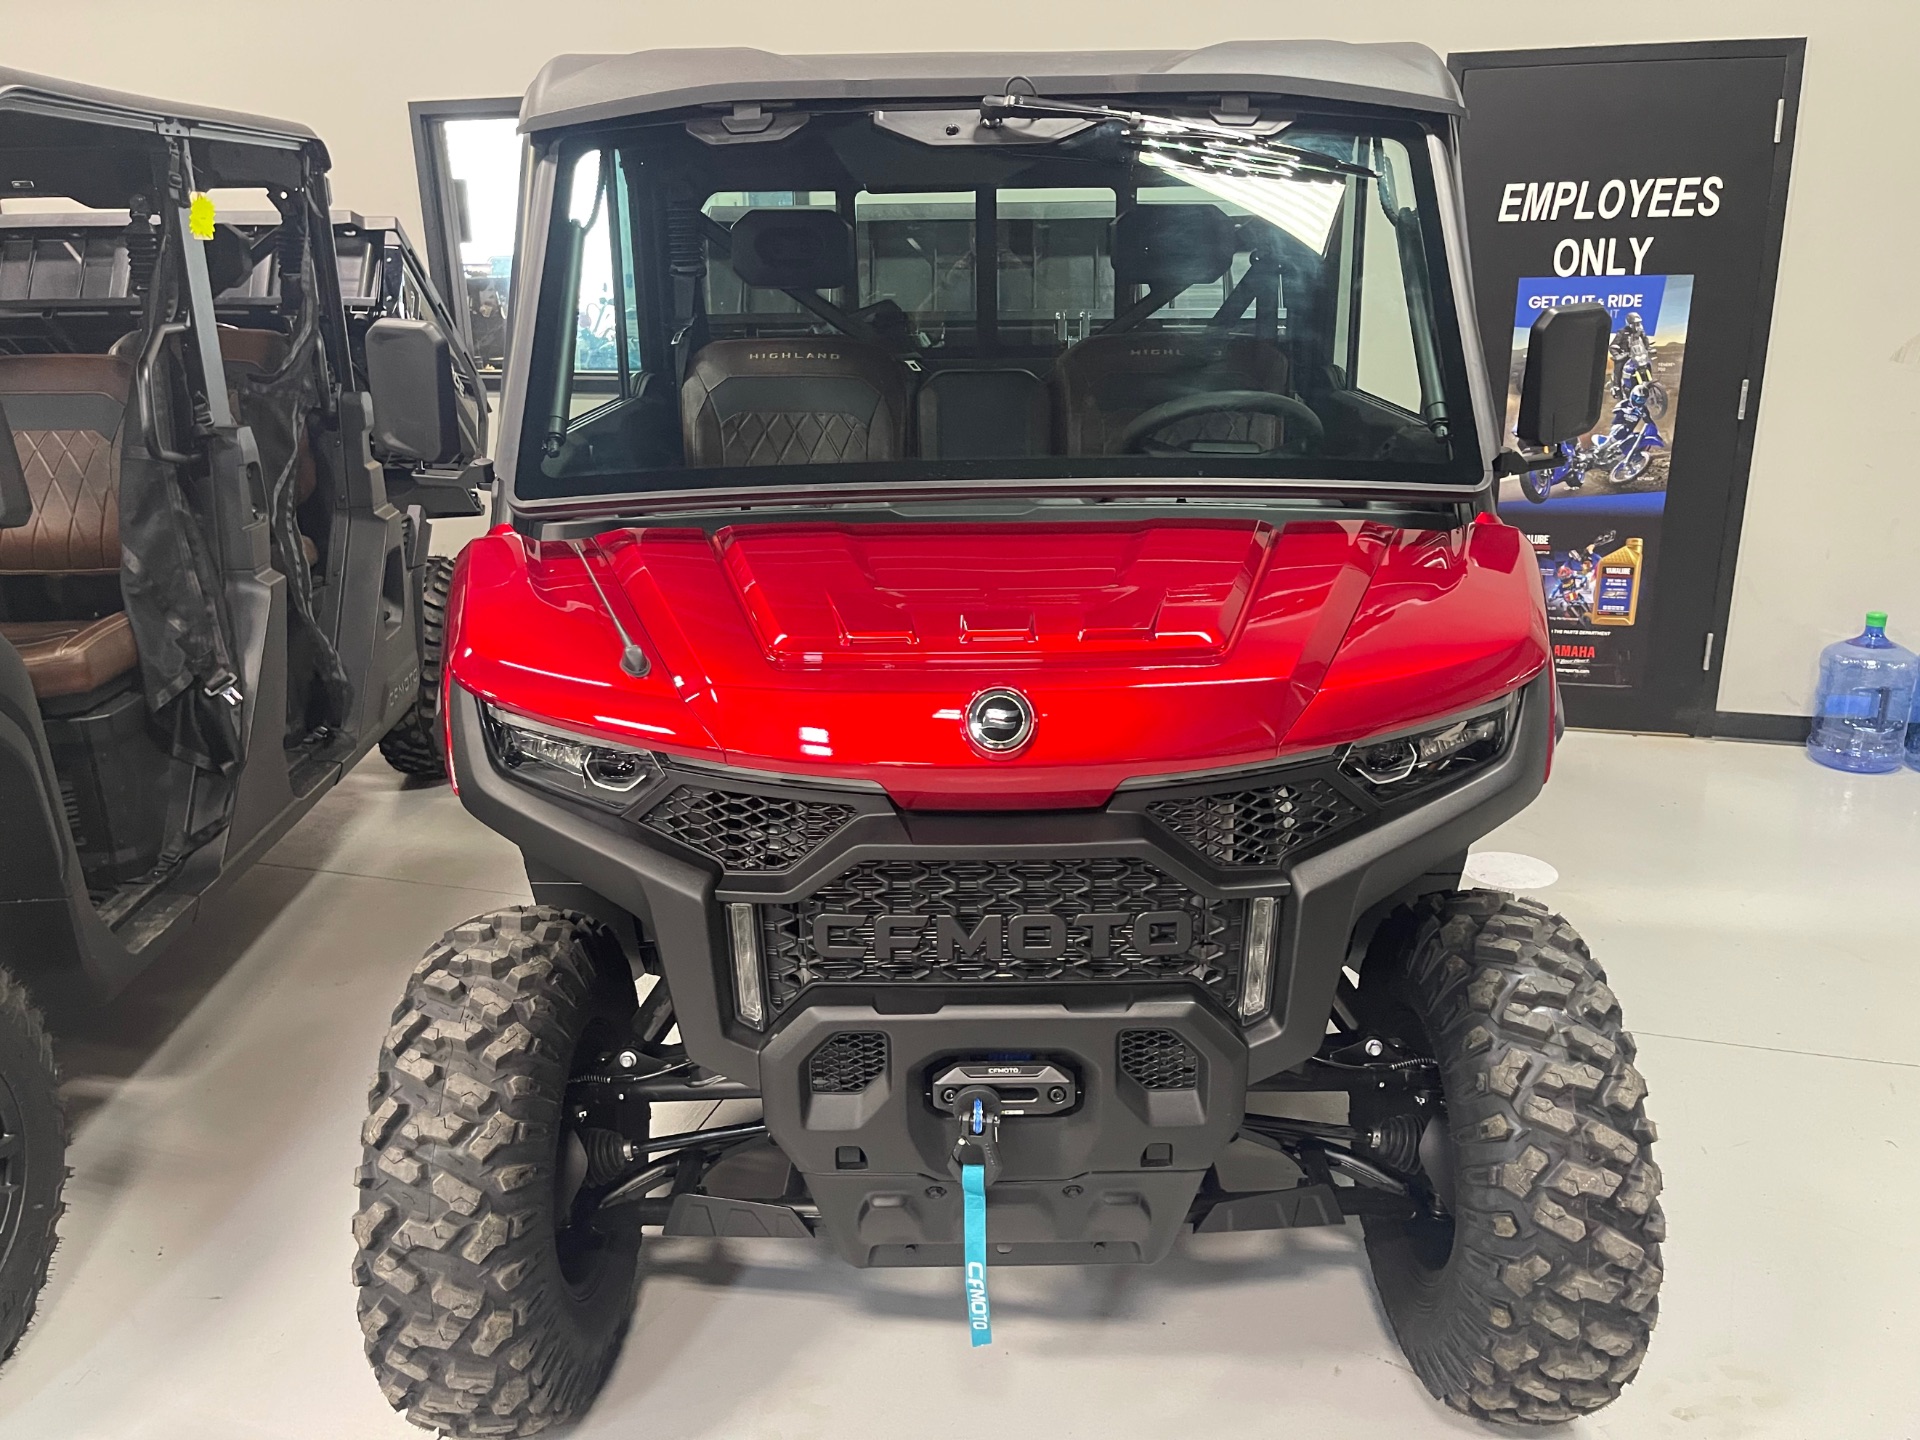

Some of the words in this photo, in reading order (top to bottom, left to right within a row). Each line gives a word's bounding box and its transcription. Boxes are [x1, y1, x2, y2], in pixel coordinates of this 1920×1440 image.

[1498, 176, 1724, 222] EMPLOYEES
[1553, 237, 1654, 278] ONLY
[1528, 295, 1559, 309] GET
[1607, 294, 1643, 308] RIDE
[749, 352, 840, 360] HIGHLAND
[1554, 644, 1595, 658] AMAHA
[389, 667, 418, 706] CFMOTO
[813, 911, 1193, 960] CFMOTO
[967, 1261, 988, 1330] CFMOTO
